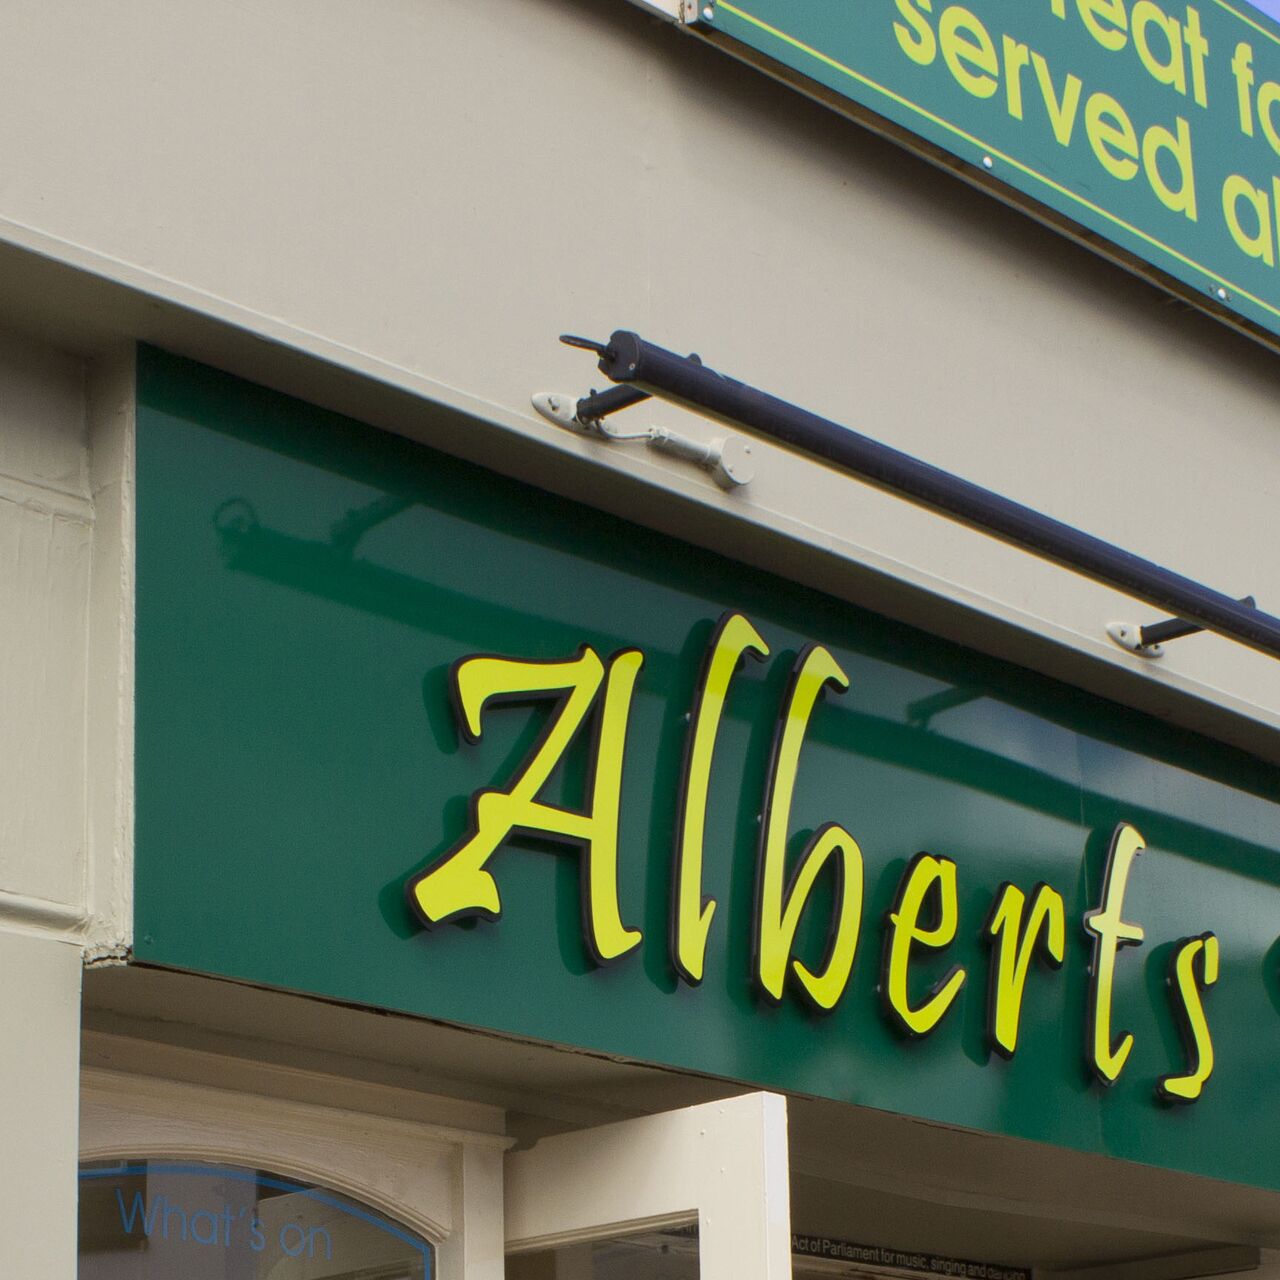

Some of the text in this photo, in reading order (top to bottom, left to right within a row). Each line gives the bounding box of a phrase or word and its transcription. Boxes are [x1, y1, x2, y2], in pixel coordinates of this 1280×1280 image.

[1051, 0, 1209, 109] eat
[893, 0, 1198, 223] served
[404, 608, 1220, 1105] Alberts
[115, 1187, 333, 1261] What's on
[822, 1239, 880, 1260] Parliament
[881, 1247, 895, 1263] for
